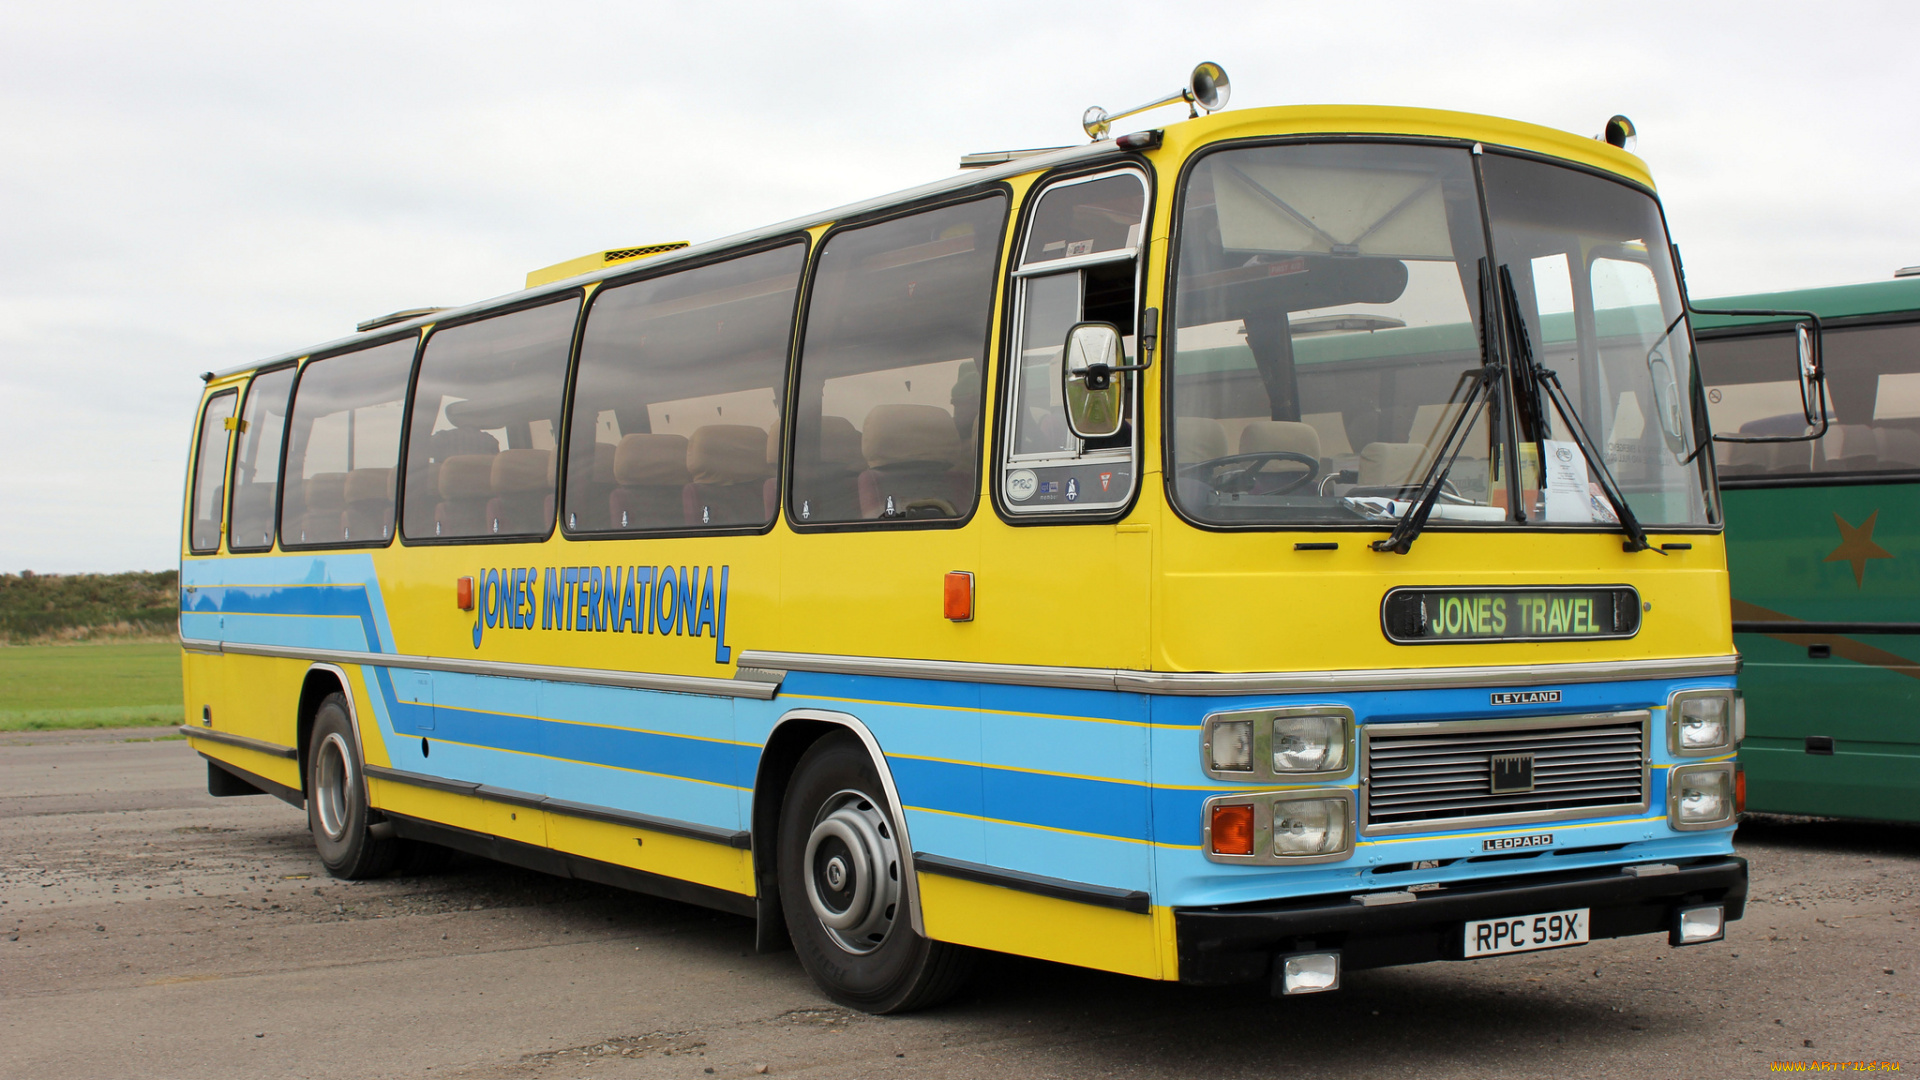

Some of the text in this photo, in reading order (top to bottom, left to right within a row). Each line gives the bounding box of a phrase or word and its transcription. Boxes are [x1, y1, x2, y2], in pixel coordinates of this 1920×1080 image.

[473, 565, 731, 664] JONES INTERNATIONAL
[1432, 597, 1600, 634] JONES TRAVEL
[1494, 691, 1558, 704] LEYLAND
[1486, 835, 1551, 850] LEOPARD
[1476, 913, 1578, 951] RPC 59X
